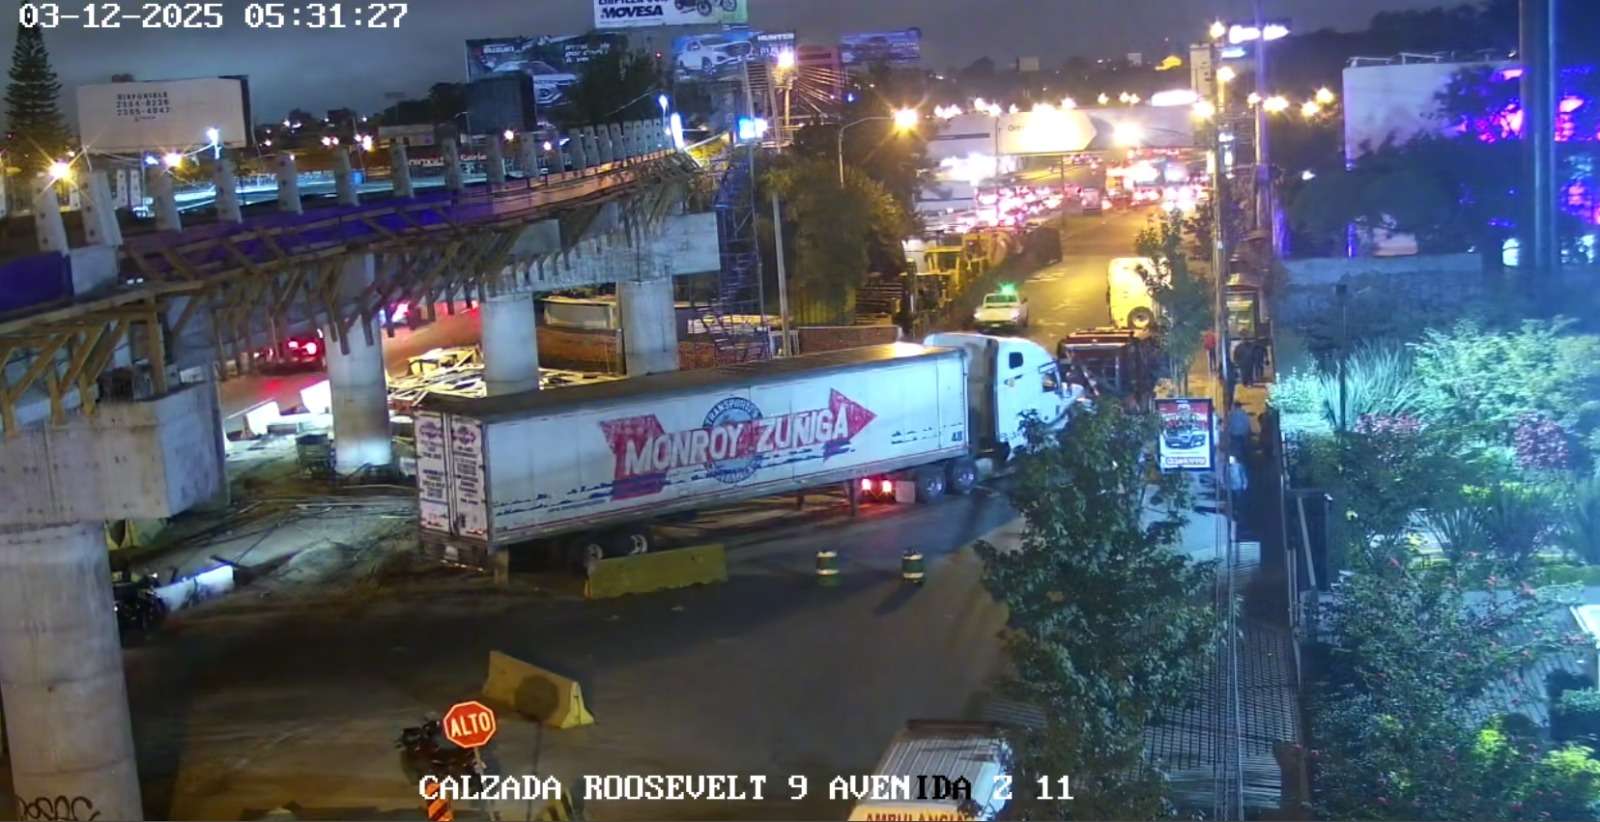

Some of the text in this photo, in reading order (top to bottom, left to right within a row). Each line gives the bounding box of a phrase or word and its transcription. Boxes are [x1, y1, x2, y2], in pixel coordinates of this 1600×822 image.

[600, 5, 664, 19] MOVESA
[624, 423, 744, 475] MONROY
[450, 711, 491, 737] ALTO
